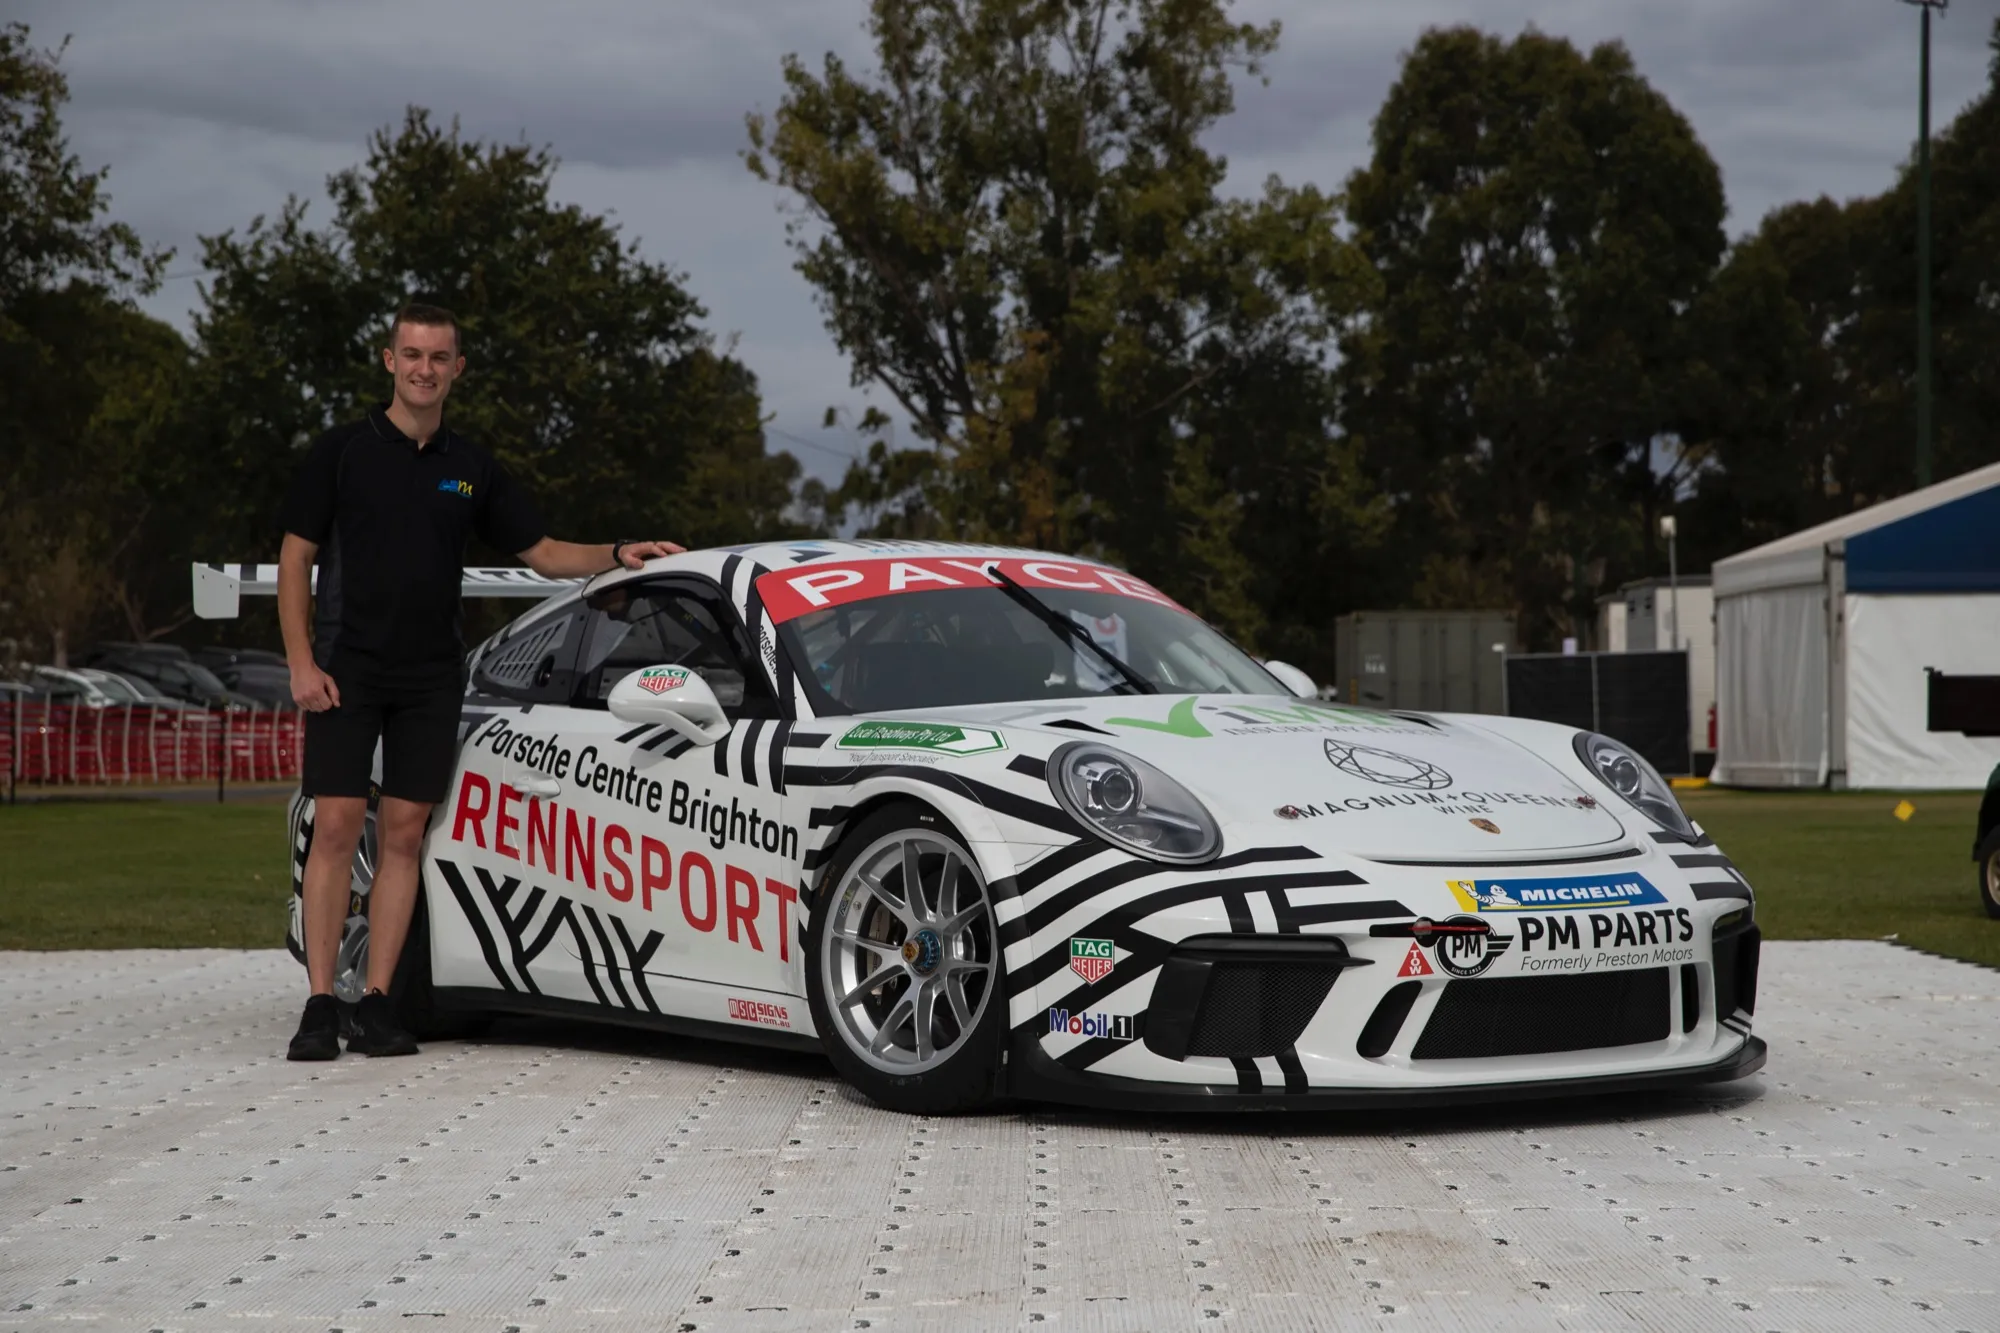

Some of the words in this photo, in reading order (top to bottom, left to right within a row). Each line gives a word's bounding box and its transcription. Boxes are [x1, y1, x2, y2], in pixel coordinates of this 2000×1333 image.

[786, 560, 1173, 607] PAYCE
[640, 677, 683, 692] HEUER
[648, 669, 685, 678] TAG
[474, 717, 571, 779] Porsche
[574, 745, 662, 813] Centre
[668, 779, 799, 861] Brighton
[1433, 802, 1494, 815] WINE
[451, 769, 798, 964] RENNSPORT
[1520, 883, 1643, 902] MICHELIN
[1517, 915, 1580, 952] PM
[1588, 907, 1694, 949] PARTS
[1074, 940, 1110, 957] TAG
[1452, 934, 1482, 959] PM
[1073, 958, 1112, 981] HEUER
[1409, 949, 1422, 975] TOW
[1451, 966, 1468, 976] SINCE
[1520, 953, 1593, 972] Formerly
[1596, 951, 1649, 967] Preston
[1651, 947, 1694, 964] Motors
[757, 1002, 789, 1020] SIGNS
[758, 1016, 791, 1028] com.au
[1050, 1008, 1108, 1038] Mobil
